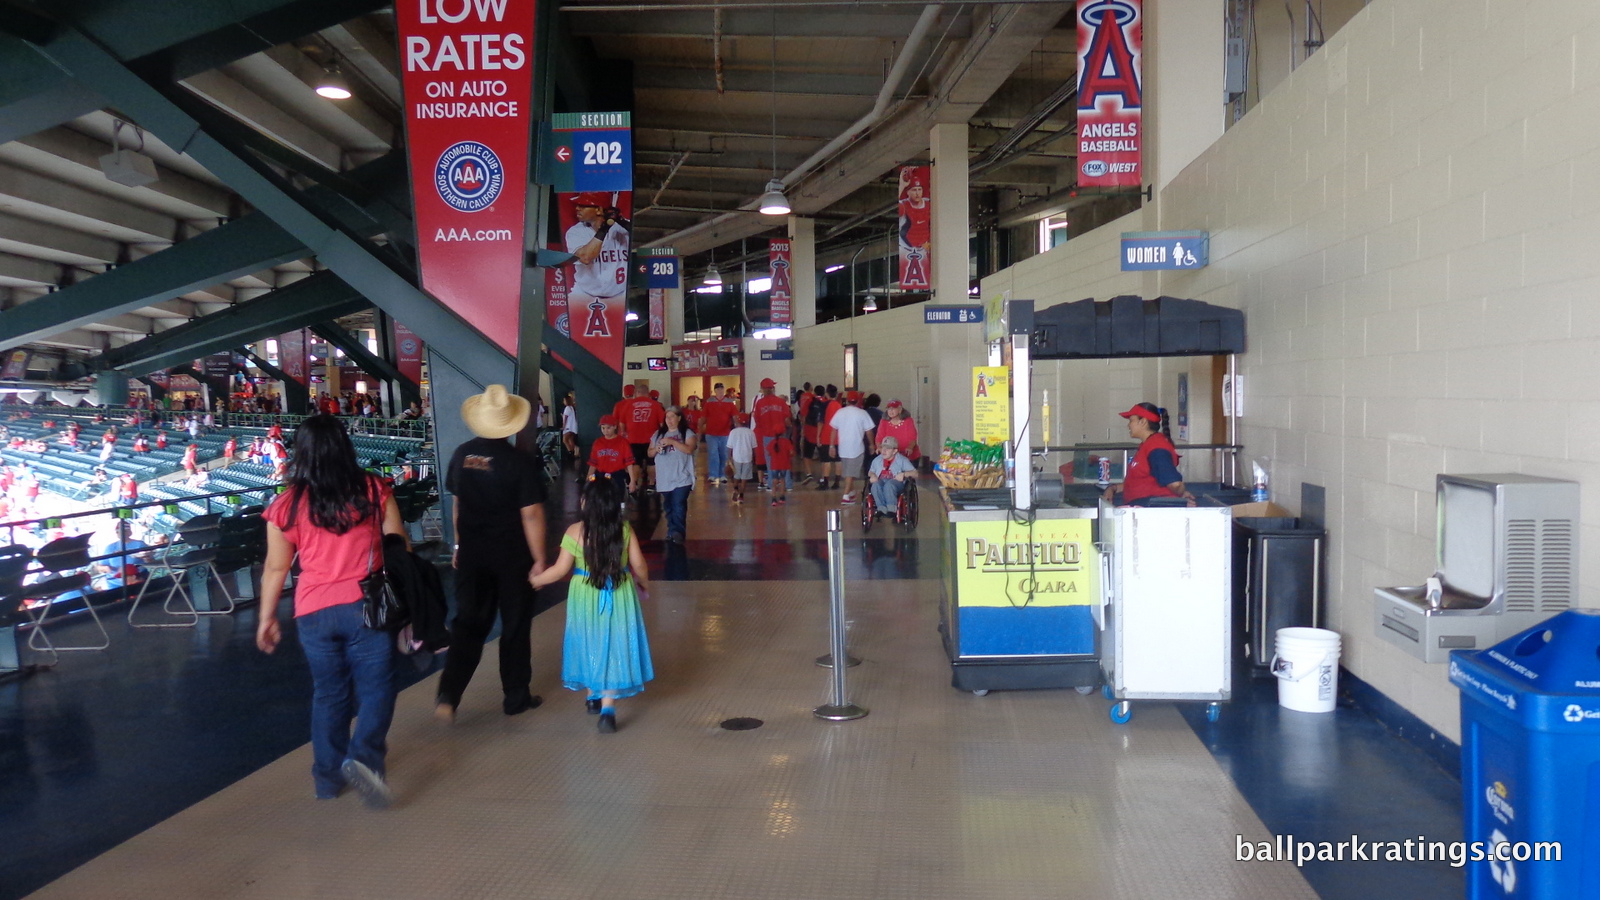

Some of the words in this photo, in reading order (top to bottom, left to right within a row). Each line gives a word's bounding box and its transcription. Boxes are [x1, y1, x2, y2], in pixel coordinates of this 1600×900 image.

[419, 0, 508, 24] LOW
[406, 33, 526, 72] RATES
[425, 81, 454, 98] ON
[460, 80, 507, 97] AUTO
[416, 101, 518, 119] INSURANCE
[581, 114, 623, 127] SECTION
[1081, 123, 1137, 138] ANGELS
[583, 141, 623, 165] 202
[1081, 140, 1138, 153] BASEBALL
[439, 144, 483, 171] AUTOMOBILE
[481, 150, 499, 170] CLUB
[453, 166, 485, 184] AAA
[1087, 163, 1103, 171] FOX
[1109, 162, 1137, 173] WEST
[437, 174, 468, 209] SOUTHERN
[468, 173, 501, 209] CALIFORNIA
[434, 227, 512, 242] AAA.com
[651, 248, 674, 256] SECTION
[770, 243, 789, 252] 2013
[1126, 246, 1166, 264] WOMEN
[615, 266, 626, 285] 6
[652, 262, 674, 275] 203
[927, 311, 951, 321] ELEVATOR
[632, 408, 652, 423] 27
[965, 537, 1082, 569] PACIFICO
